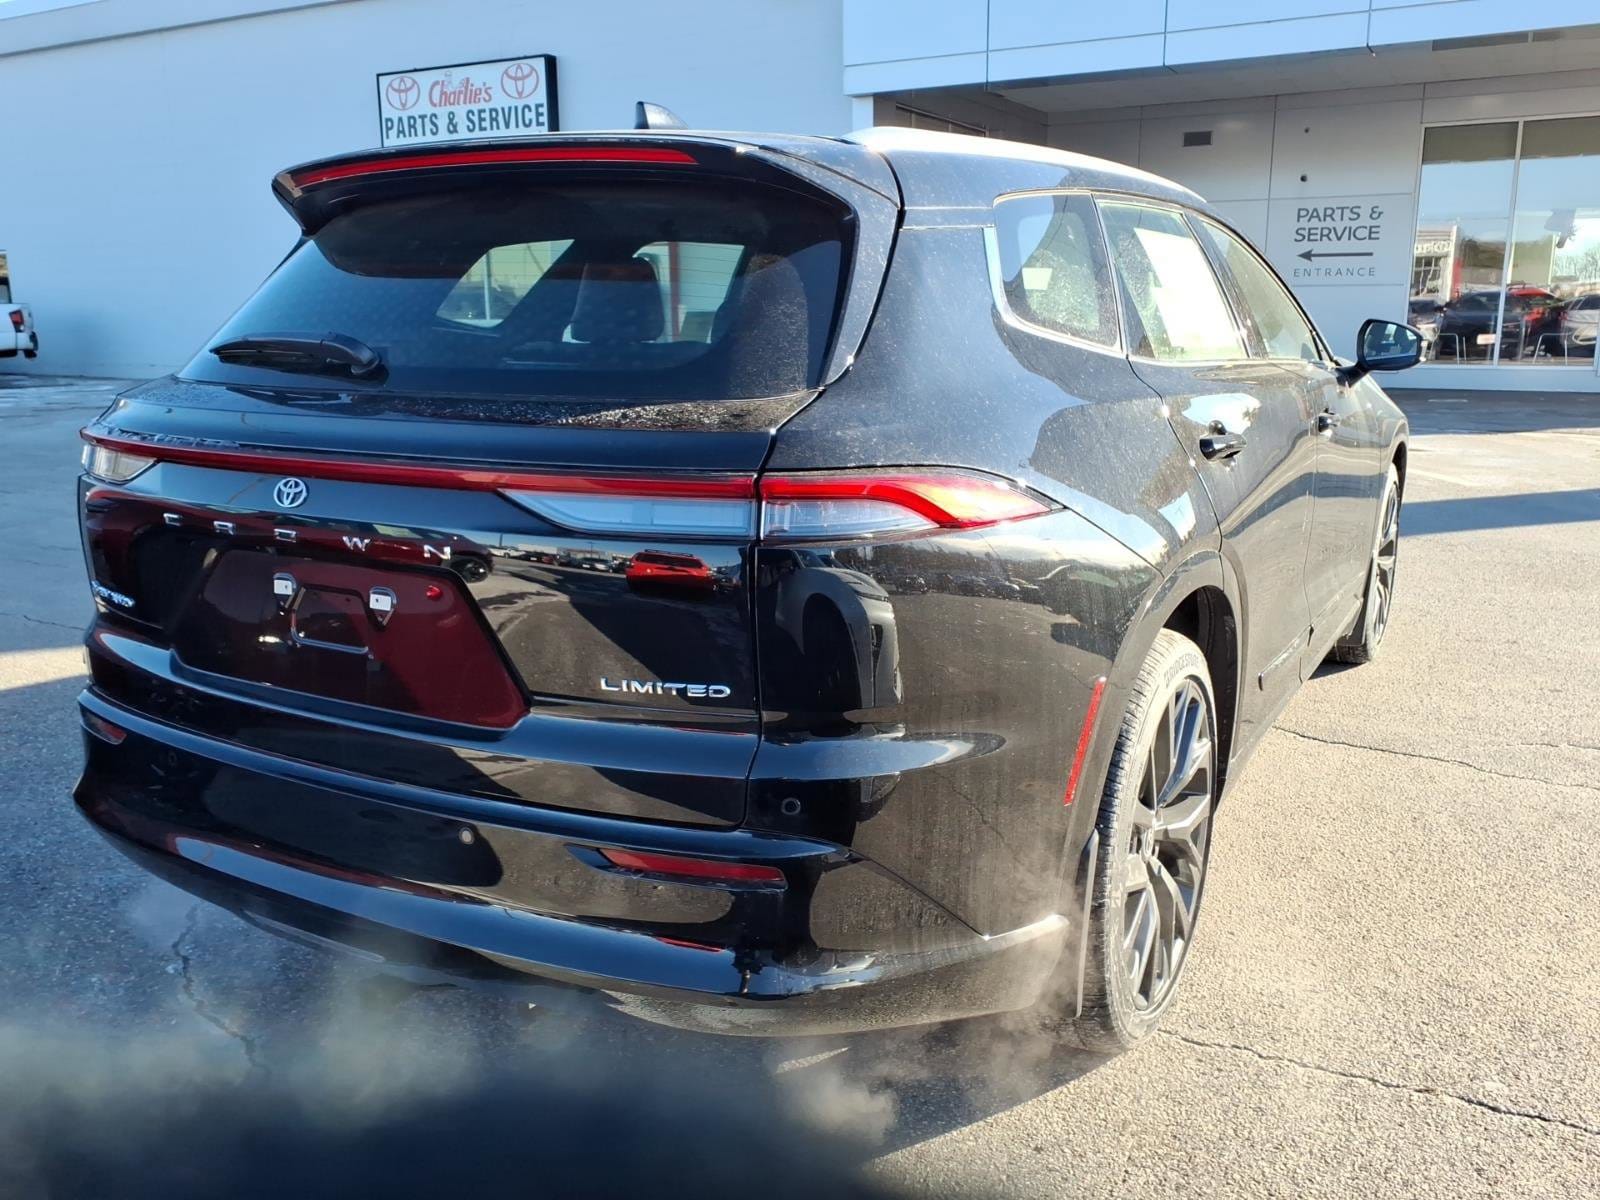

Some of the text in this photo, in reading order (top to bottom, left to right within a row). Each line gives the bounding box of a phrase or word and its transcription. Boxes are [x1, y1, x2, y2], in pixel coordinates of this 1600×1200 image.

[428, 77, 493, 108] Charlie's
[385, 103, 546, 140] PARTS & SERVICE
[1296, 205, 1384, 223] PARTS &
[1294, 225, 1380, 242] SERVICE
[1293, 266, 1376, 278] ENTRANCE
[163, 512, 452, 560] CROWN
[600, 677, 731, 698] LIMITED
